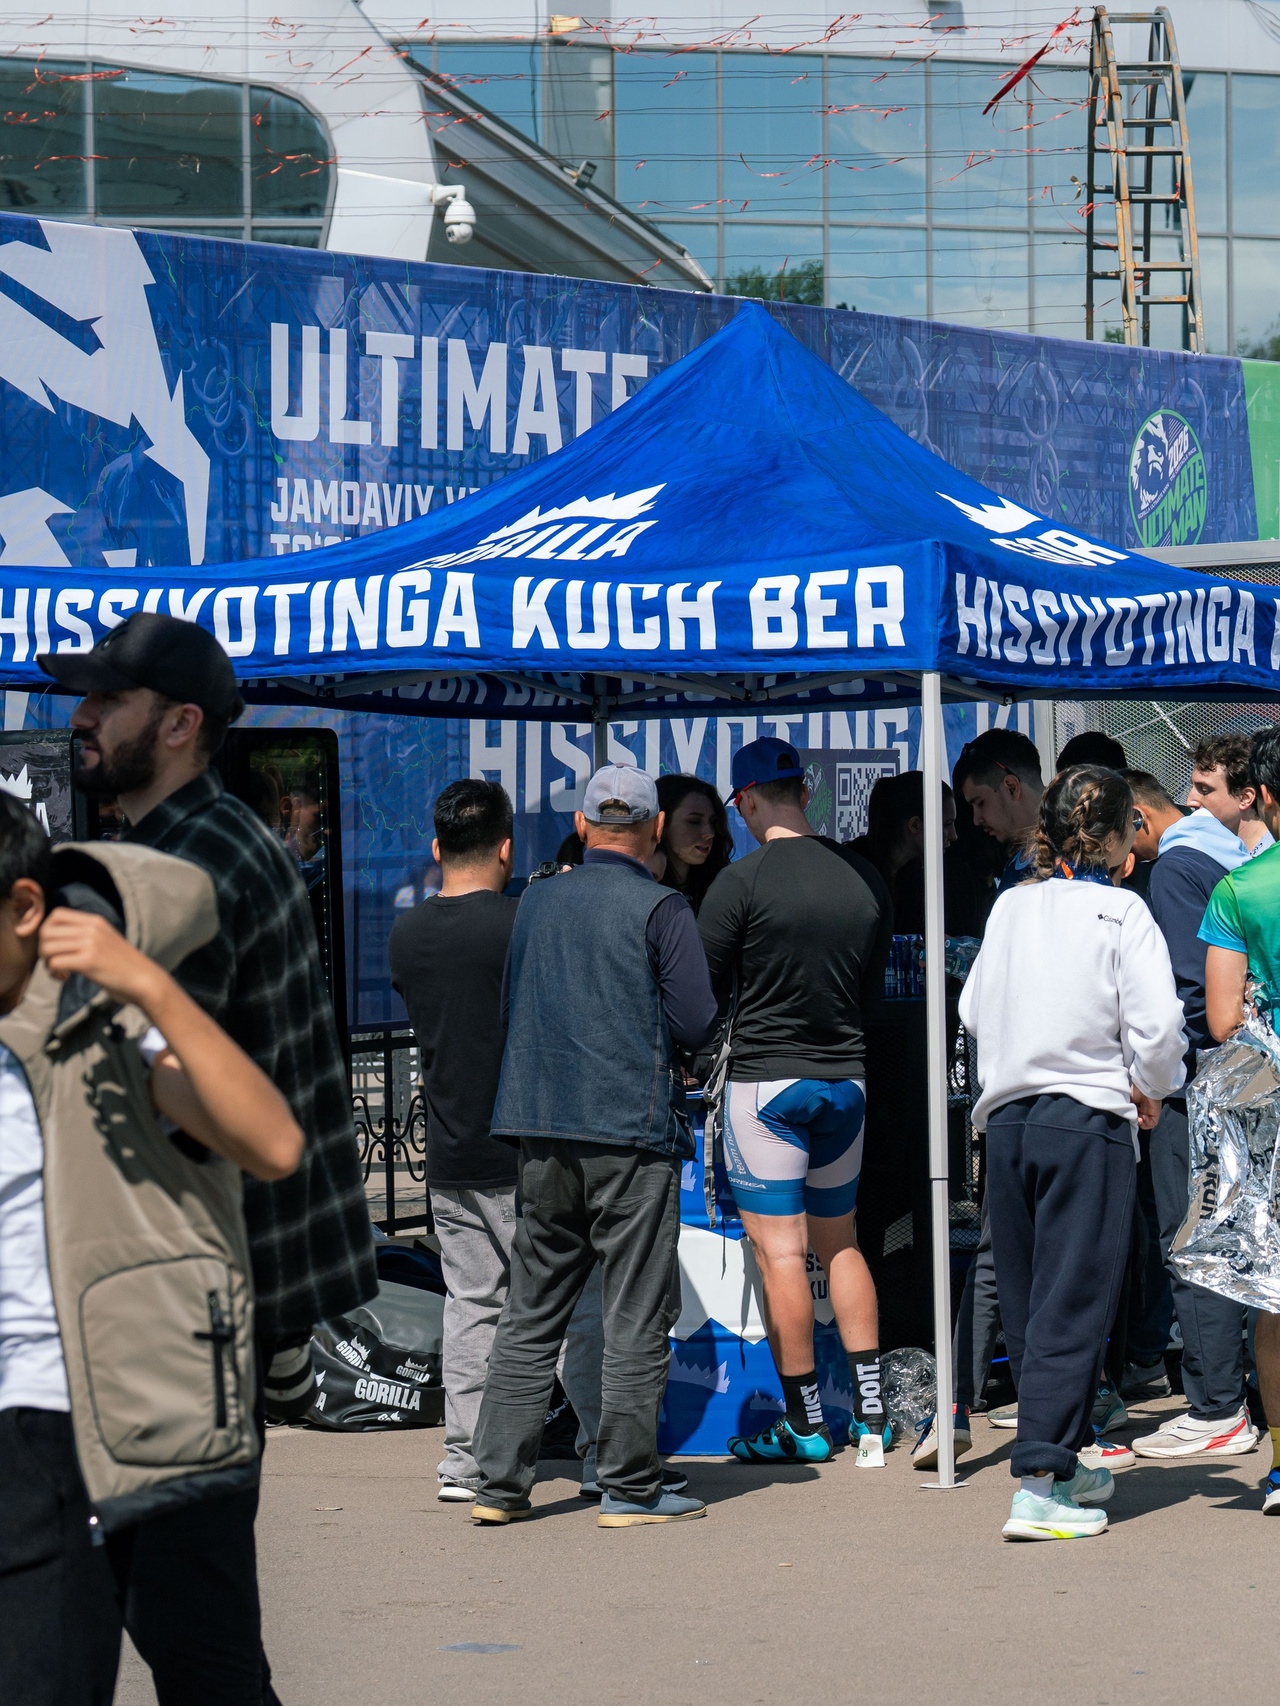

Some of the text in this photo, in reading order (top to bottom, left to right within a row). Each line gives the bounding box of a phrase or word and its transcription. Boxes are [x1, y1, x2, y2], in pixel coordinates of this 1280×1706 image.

[1168, 425, 1189, 477] 2026
[1142, 457, 1204, 548] ULTIMATE
[1171, 489, 1205, 547] MAN
[397, 520, 660, 572] GORILLA
[512, 576, 723, 652] KUCH
[749, 565, 906, 651] BER
[956, 572, 1257, 668] HISSIYOTINGA
[730, 1147, 747, 1176] team
[354, 1378, 422, 1411] GORILLA
[395, 1365, 431, 1384] GORILLA
